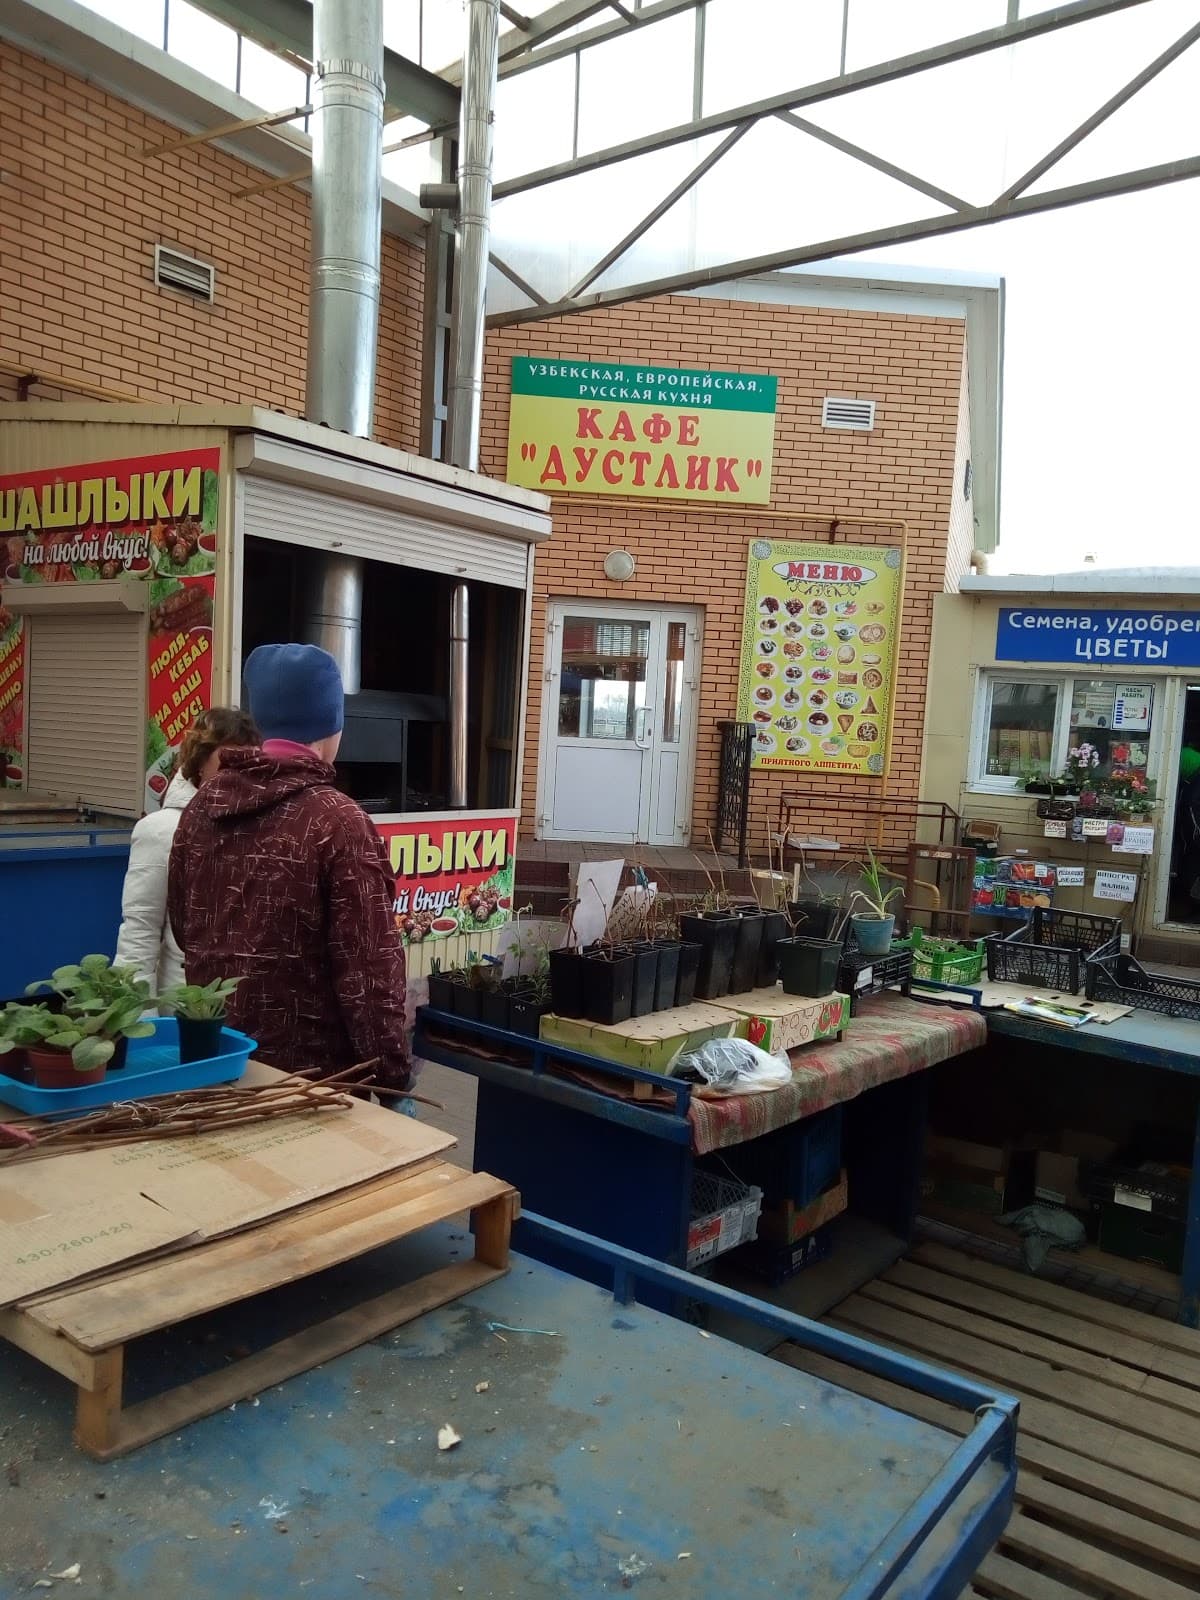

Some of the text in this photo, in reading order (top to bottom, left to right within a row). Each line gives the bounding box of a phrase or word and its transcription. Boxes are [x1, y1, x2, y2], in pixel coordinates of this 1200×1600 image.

[528, 364, 764, 393] УЗБЕКСКАЯ, ЕВРОПЕЙСКАЯ,
[578, 384, 713, 405] РУССКАЯ КУХНЯ
[575, 407, 701, 447] КАФЕ
[520, 442, 763, 493] "ДУСТЛИК"
[23, 529, 151, 568] на любой вкус!
[786, 561, 864, 583] МЕНЮ
[1008, 611, 1099, 633] Семена,
[151, 631, 190, 680] ЛЮЛЯ-
[168, 635, 210, 684] КЕБАБ
[1074, 637, 1169, 660] ЦВЕТЫ
[154, 670, 202, 727] НА ВАШ
[166, 695, 204, 741] ВКУС!
[760, 757, 862, 770] ПРИЯТНОГО АППЕТИТА!
[380, 829, 507, 875] ЛЫКИ
[412, 882, 462, 917] вкус!
